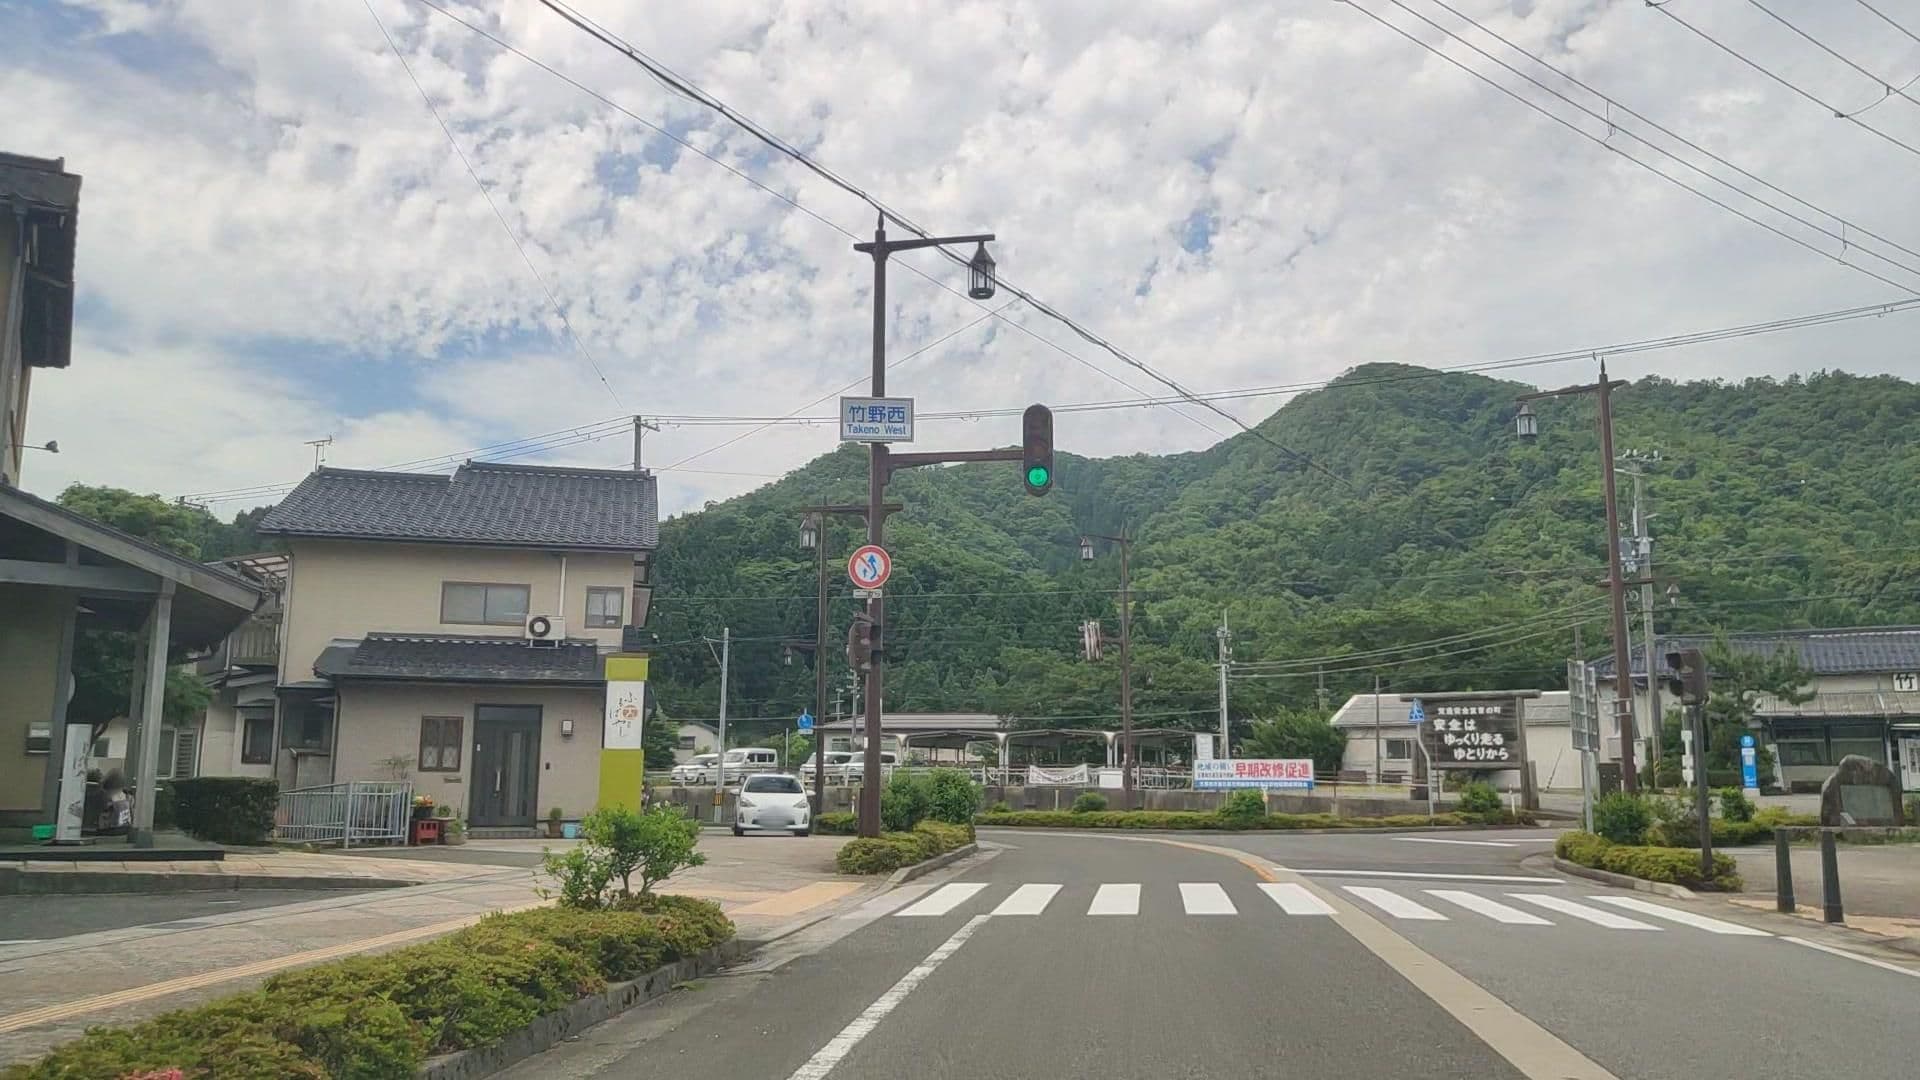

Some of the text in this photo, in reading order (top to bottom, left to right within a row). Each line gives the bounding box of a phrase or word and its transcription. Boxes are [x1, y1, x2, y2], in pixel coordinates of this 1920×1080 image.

[848, 405, 905, 423] 竹野西
[847, 423, 906, 435] Takeno West
[1895, 672, 1915, 689] 竹
[1433, 718, 1477, 731] 安全は
[1443, 733, 1504, 746] ゆっくり走る
[1453, 747, 1509, 760] ゆとりから
[1235, 762, 1310, 778] 早期改修促進
